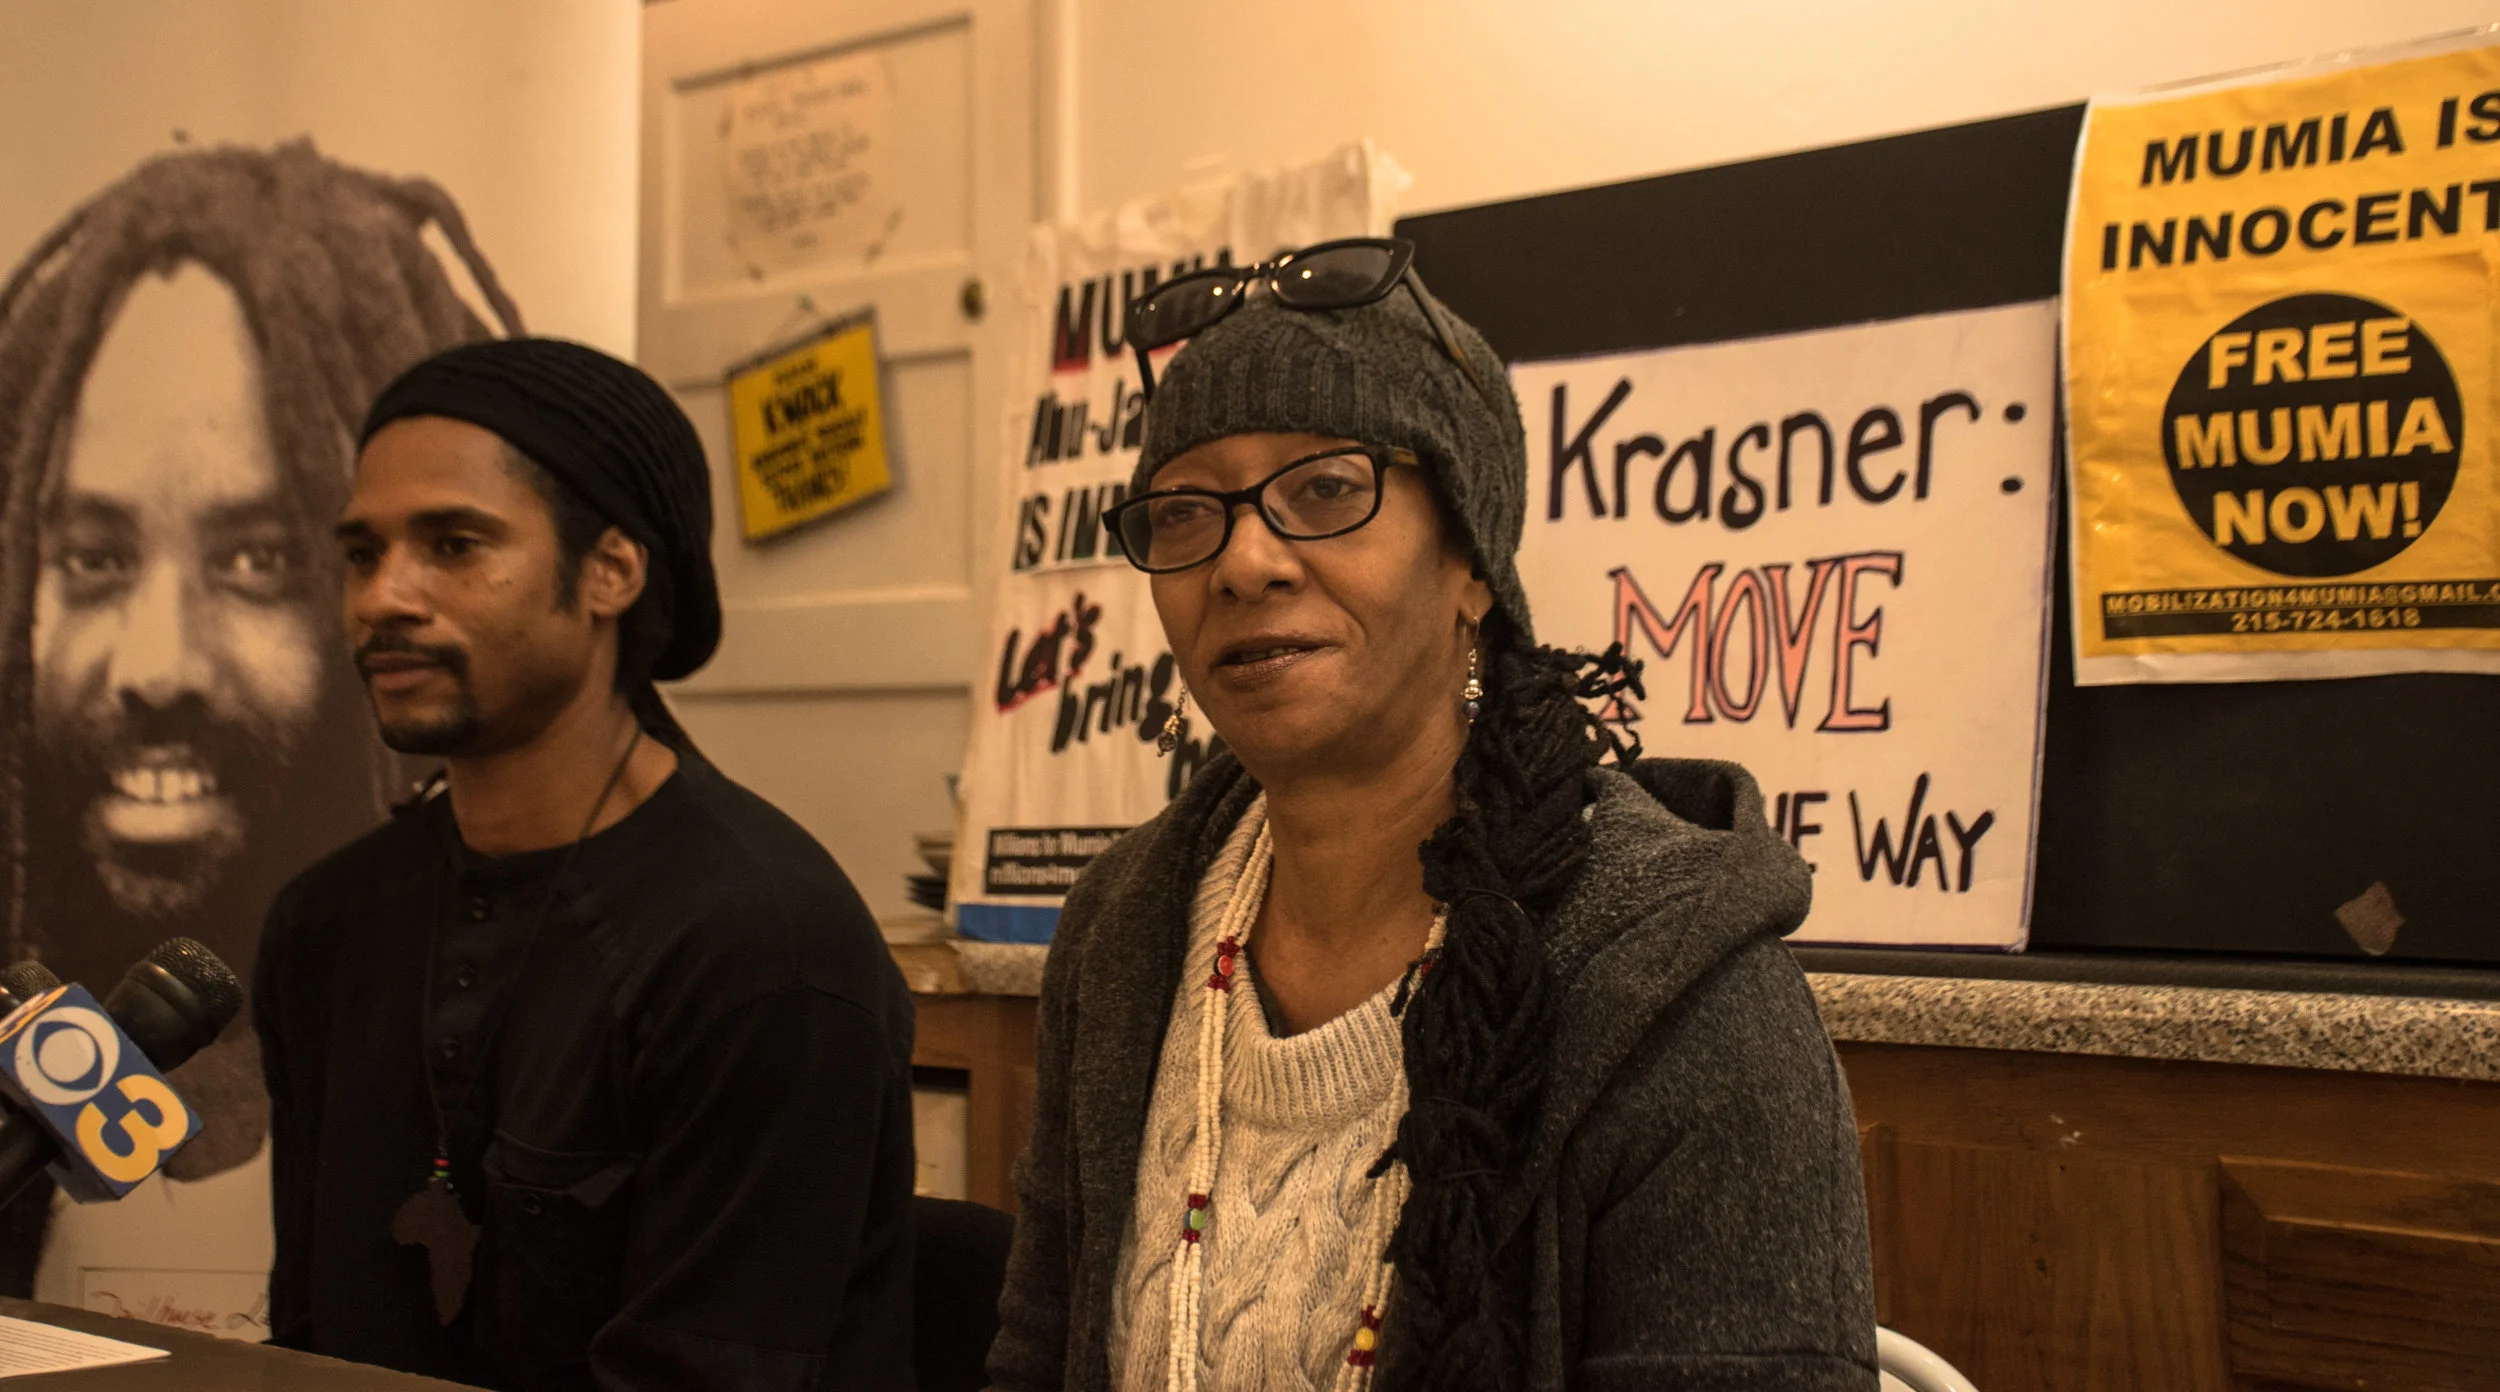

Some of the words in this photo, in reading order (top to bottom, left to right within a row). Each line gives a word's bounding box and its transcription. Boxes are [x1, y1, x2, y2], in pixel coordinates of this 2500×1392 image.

[2139, 106, 2407, 188] MUMIA
[2436, 91, 2500, 149] IS
[2101, 178, 2500, 273] INNOCENT
[2208, 317, 2412, 390] FREE
[1547, 377, 2027, 531] Krasner:
[2174, 397, 2454, 470] MUMIA
[2213, 481, 2423, 547] NOW!
[1600, 551, 1905, 733] MOVE
[2230, 608, 2422, 633] 215-724-1618
[1051, 652, 1178, 754] bring
[1848, 771, 1996, 893] WAY
[75, 1074, 189, 1183] 3
